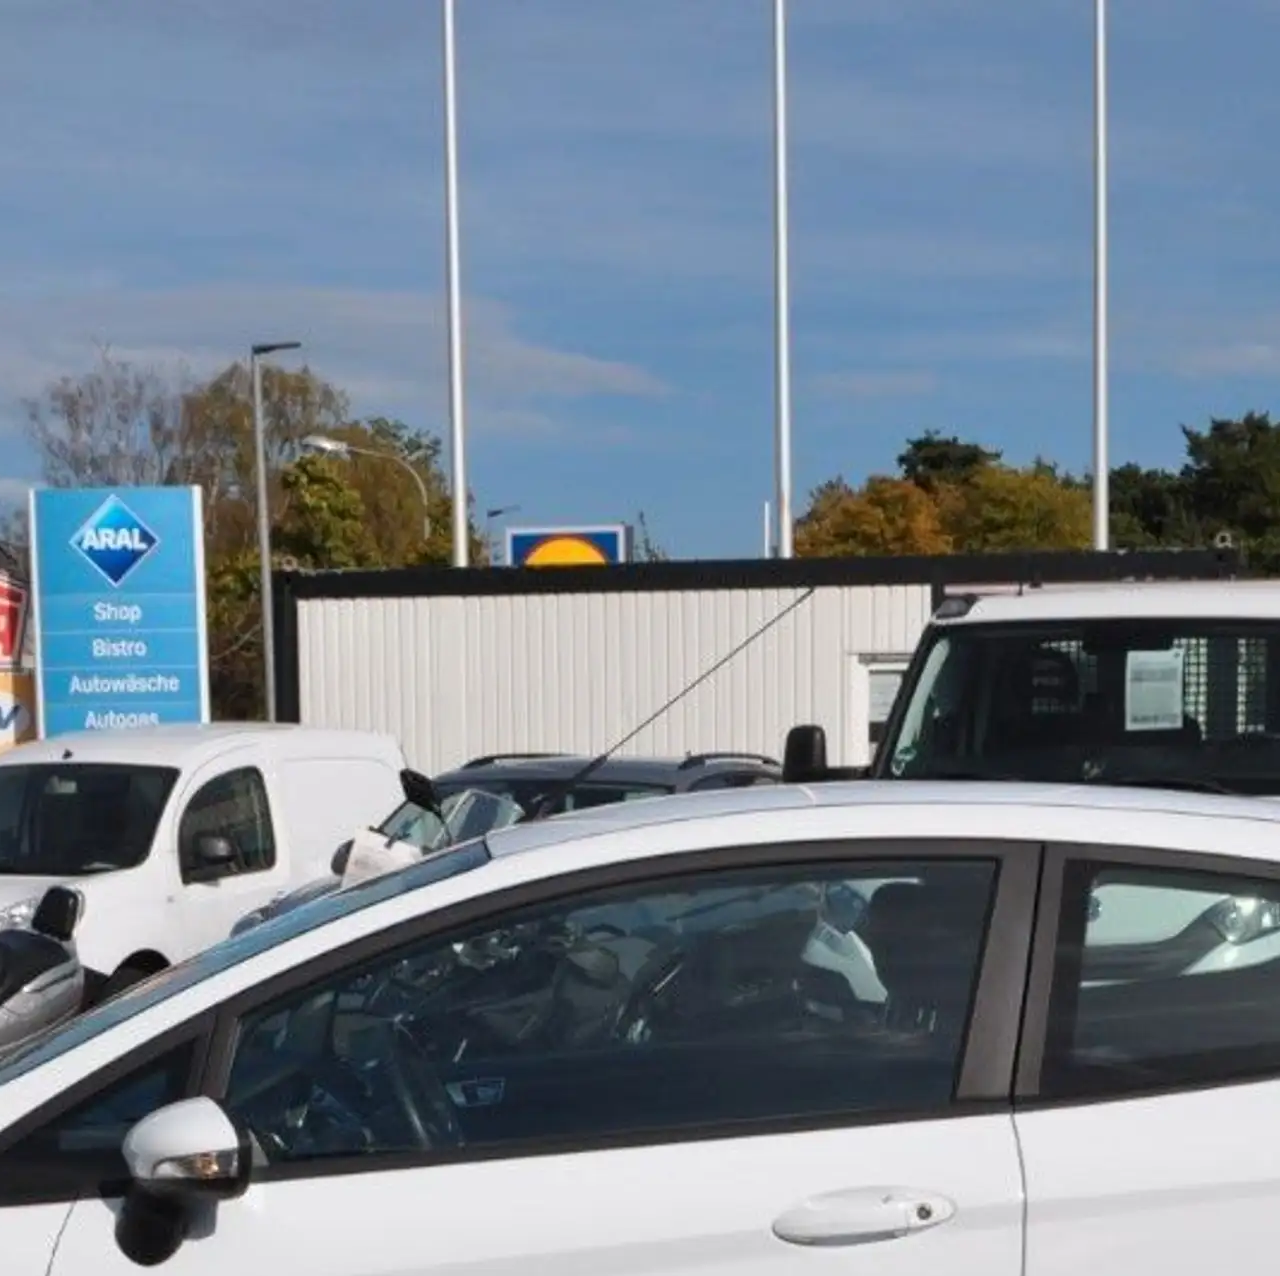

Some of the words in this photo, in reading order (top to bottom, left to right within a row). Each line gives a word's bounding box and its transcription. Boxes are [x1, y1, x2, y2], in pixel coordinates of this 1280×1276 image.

[81, 527, 149, 551] ARAL
[94, 602, 143, 624] Shop
[92, 639, 148, 657] Bistro
[70, 674, 181, 694] Autowäsche
